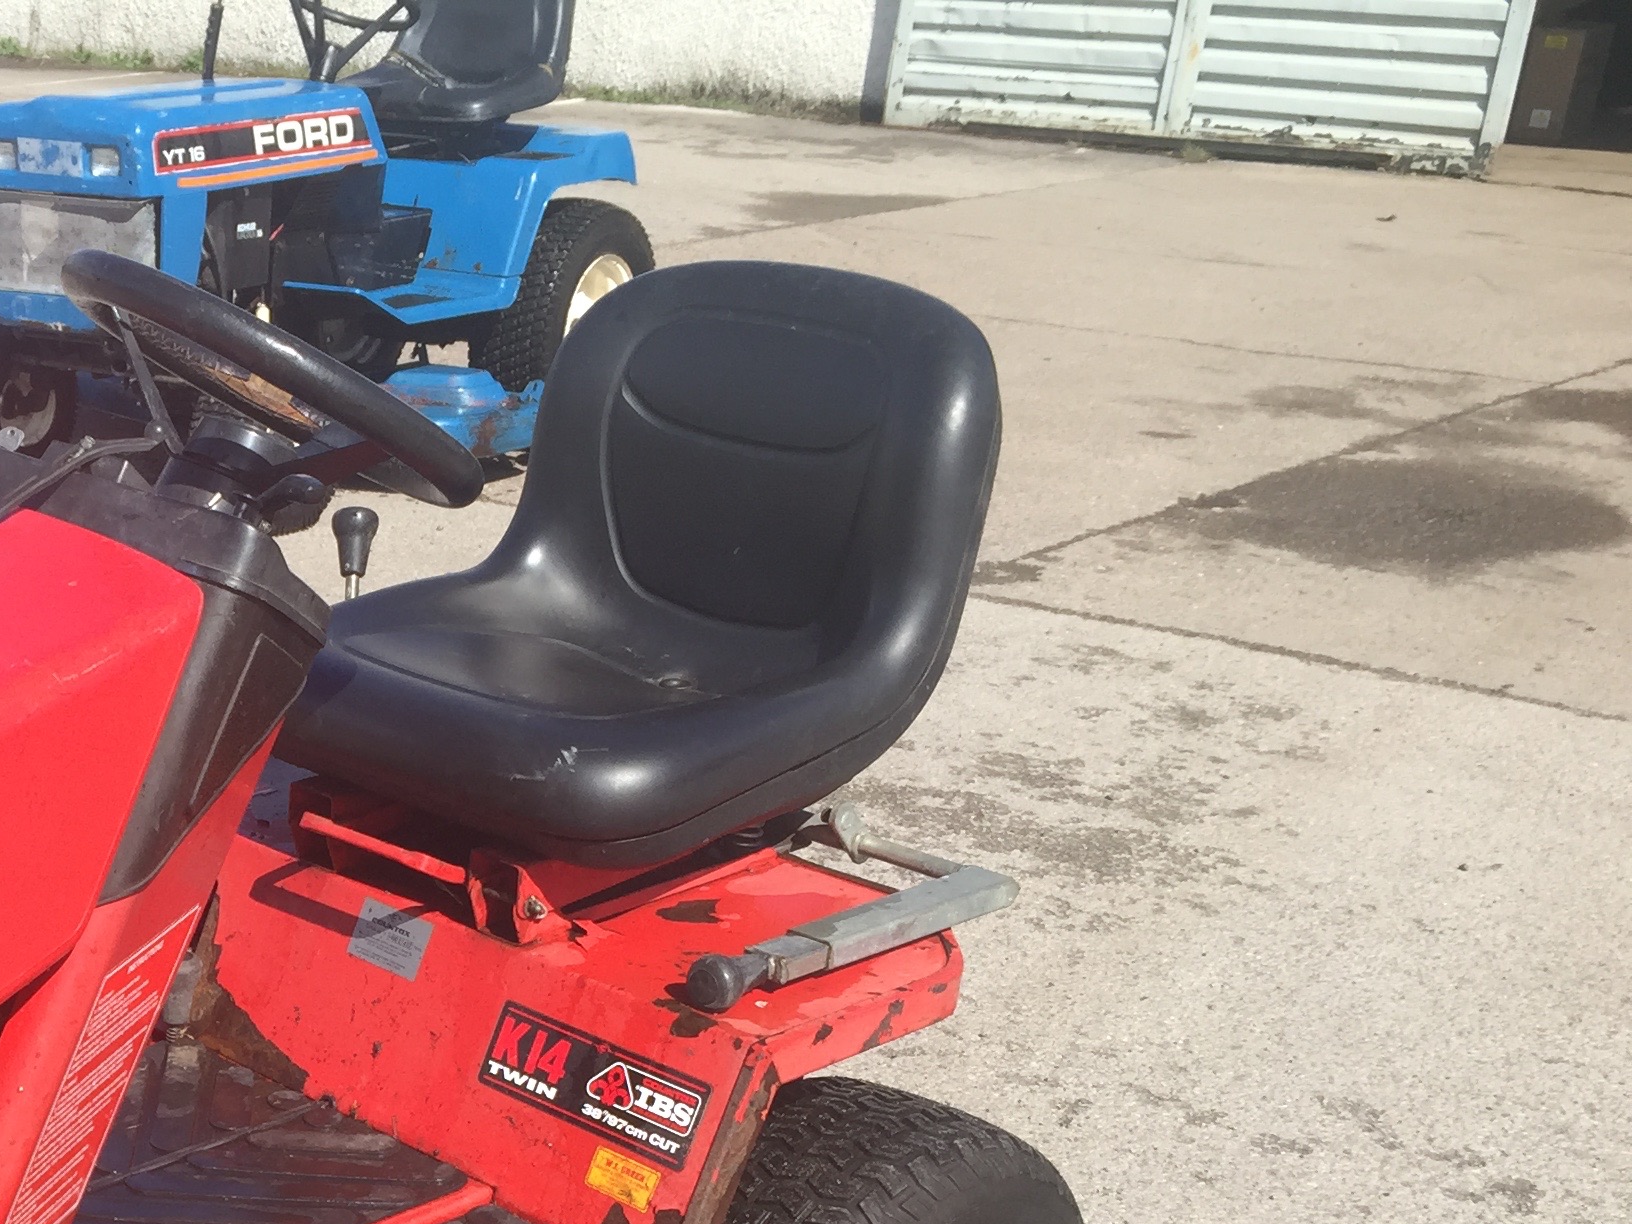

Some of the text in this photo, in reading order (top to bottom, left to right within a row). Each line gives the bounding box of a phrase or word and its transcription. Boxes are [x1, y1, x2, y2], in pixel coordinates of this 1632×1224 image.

[162, 145, 206, 166] YT 16
[252, 114, 355, 156] FORD
[491, 1016, 572, 1085] K14
[488, 1059, 558, 1100] TWIN
[648, 1133, 681, 1154] CUT
